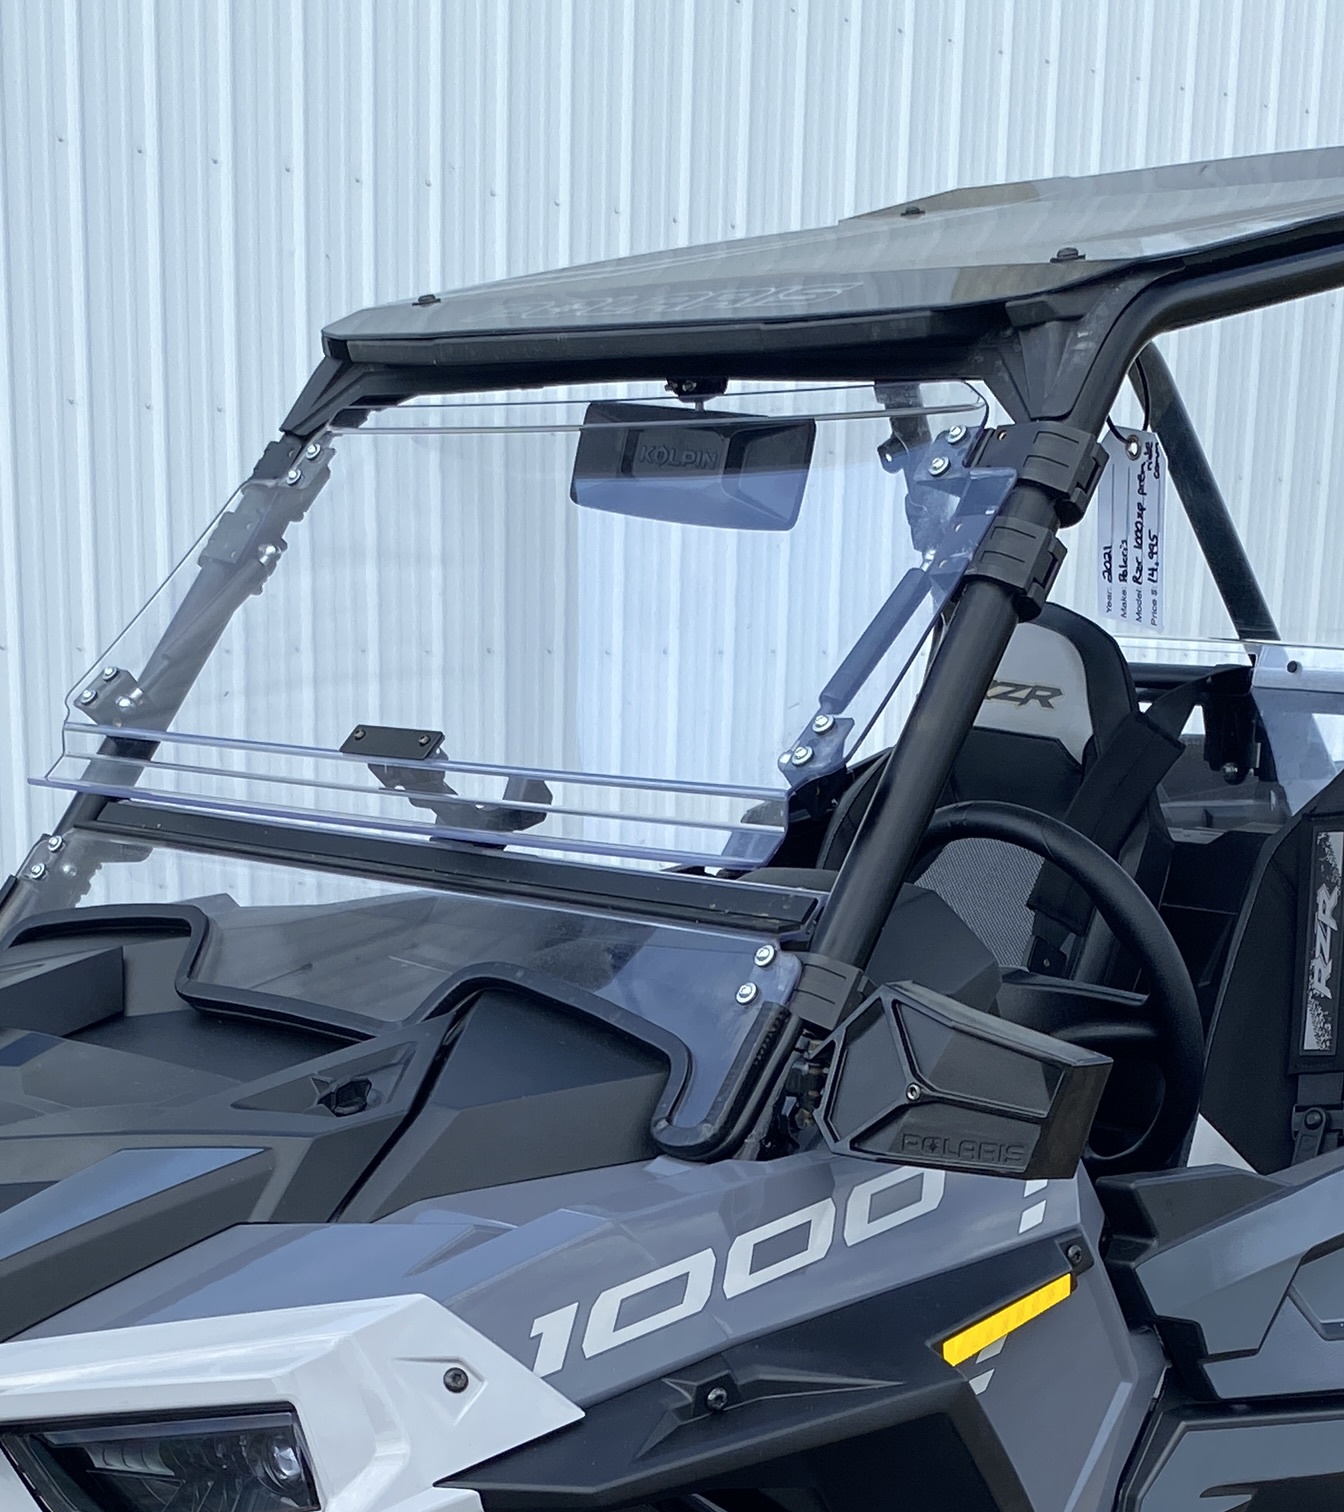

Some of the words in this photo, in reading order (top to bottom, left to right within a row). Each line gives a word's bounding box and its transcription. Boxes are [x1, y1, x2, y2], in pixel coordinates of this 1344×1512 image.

[639, 444, 719, 469] KOLPIN
[1102, 545, 1113, 583] 2021
[1120, 586, 1128, 618] Make:
[1135, 585, 1143, 622] Model:
[1150, 599, 1158, 626] Price
[986, 680, 1063, 709] ZR
[1312, 883, 1339, 1000] RZR
[902, 1132, 1025, 1164] POLARIS
[529, 1166, 946, 1377] 1000
